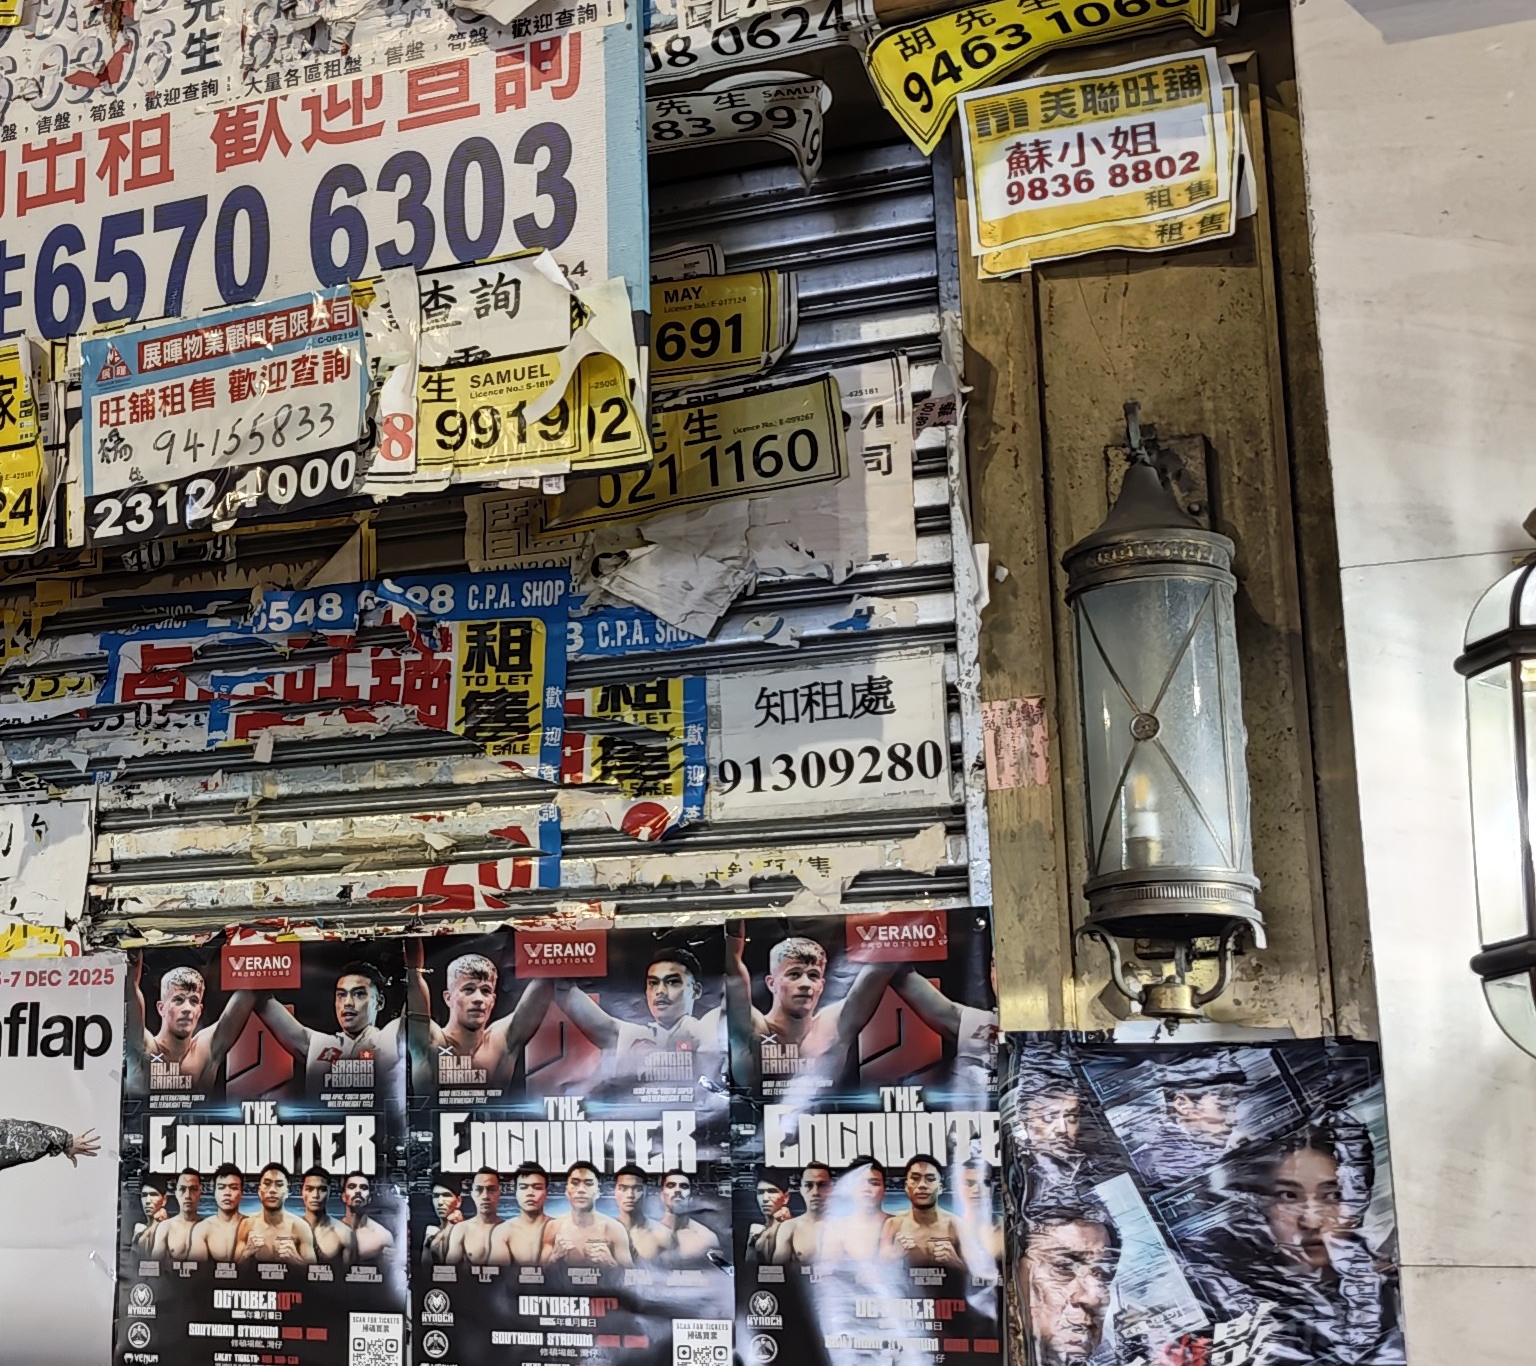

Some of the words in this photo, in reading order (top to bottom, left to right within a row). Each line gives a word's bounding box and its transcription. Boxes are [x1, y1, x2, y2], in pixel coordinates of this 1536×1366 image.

[904, 23, 1033, 113] 9463
[1006, 121, 1161, 181] 蘇小姐
[1007, 171, 1095, 206] 9836
[1108, 150, 1200, 187] 8802
[33, 184, 270, 339] 6570
[309, 121, 580, 286] 6303
[140, 297, 355, 371] 展暉物業顧問有限公司
[98, 378, 218, 427] 旺舖租售
[228, 353, 351, 402] 歡迎查詢
[470, 363, 550, 388] SAMUEL
[154, 402, 337, 465] 94155833
[467, 584, 517, 611] C.P.A.
[521, 579, 565, 607] SHOP
[754, 674, 894, 730] 知租處
[717, 738, 942, 796] 91309280
[25, 969, 63, 987] DEC
[68, 968, 114, 987] 2025
[229, 956, 291, 971] VERANO
[242, 1101, 277, 1126] THE
